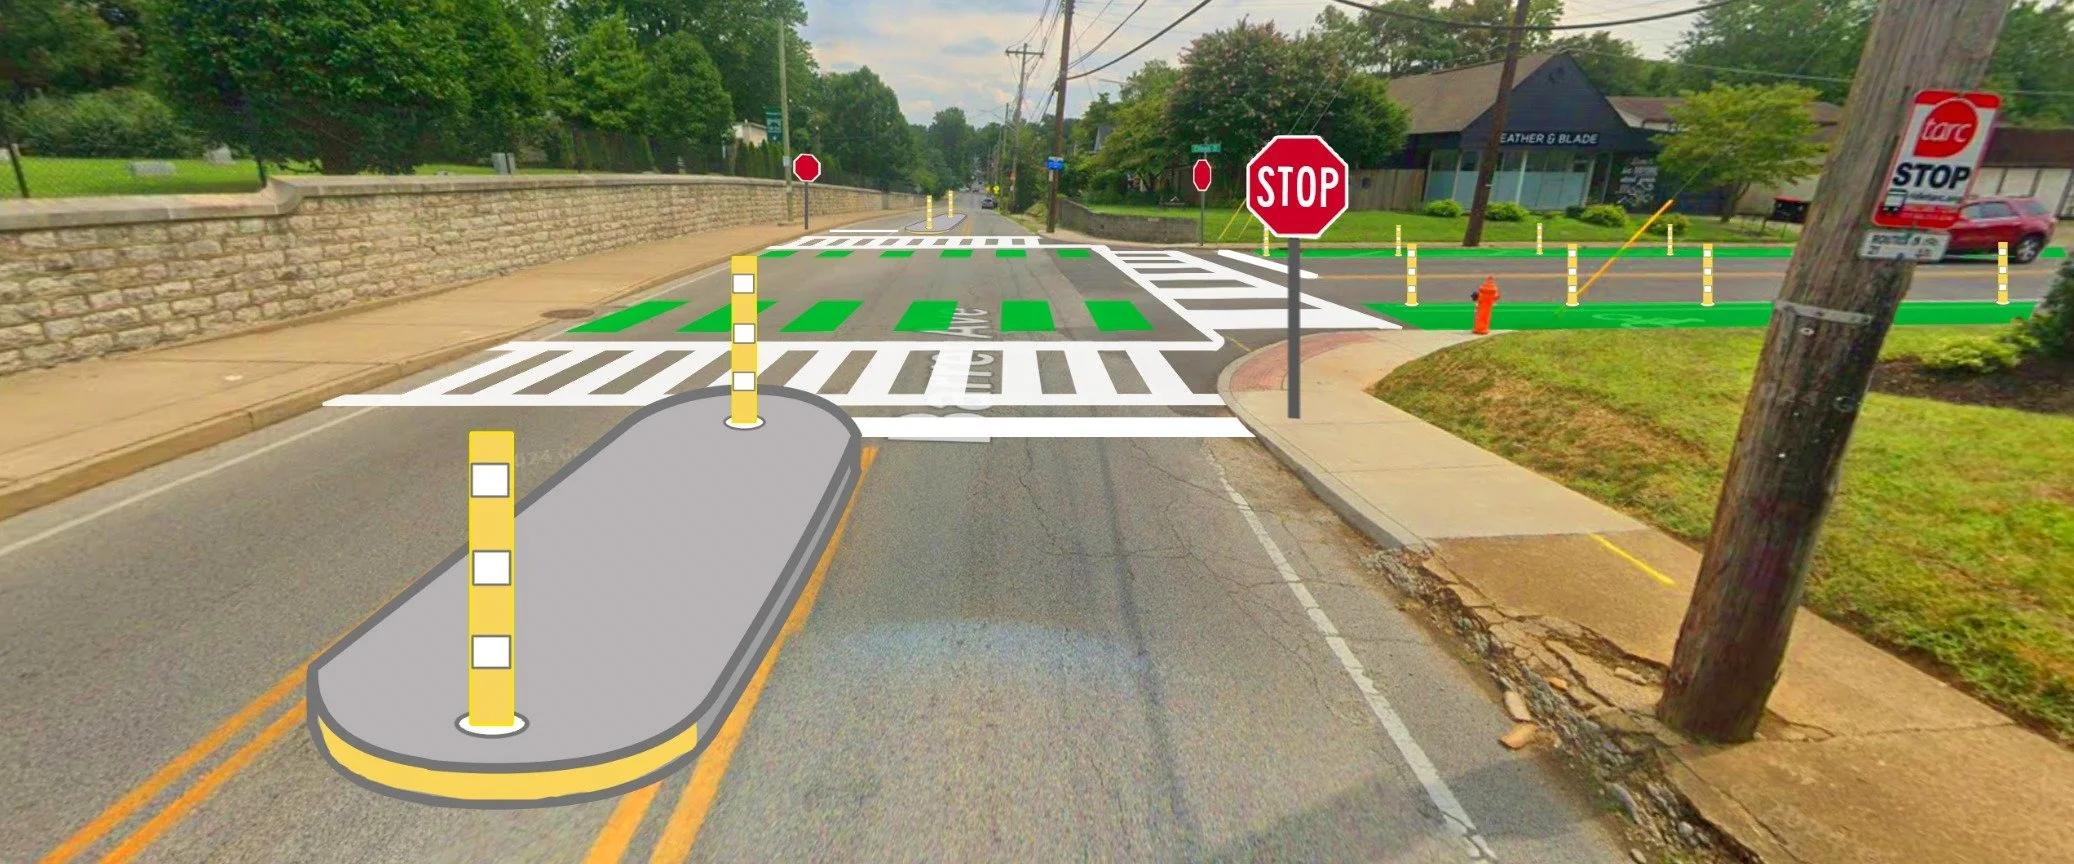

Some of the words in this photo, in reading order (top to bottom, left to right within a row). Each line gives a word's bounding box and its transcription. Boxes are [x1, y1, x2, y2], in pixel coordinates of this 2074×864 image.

[1500, 132, 1545, 143] EATHER
[1547, 133, 1555, 144] &
[1558, 133, 1599, 144] BLADE
[1921, 117, 1972, 143] tarc
[1256, 165, 1339, 208] STOP
[1892, 162, 1972, 189] STOP
